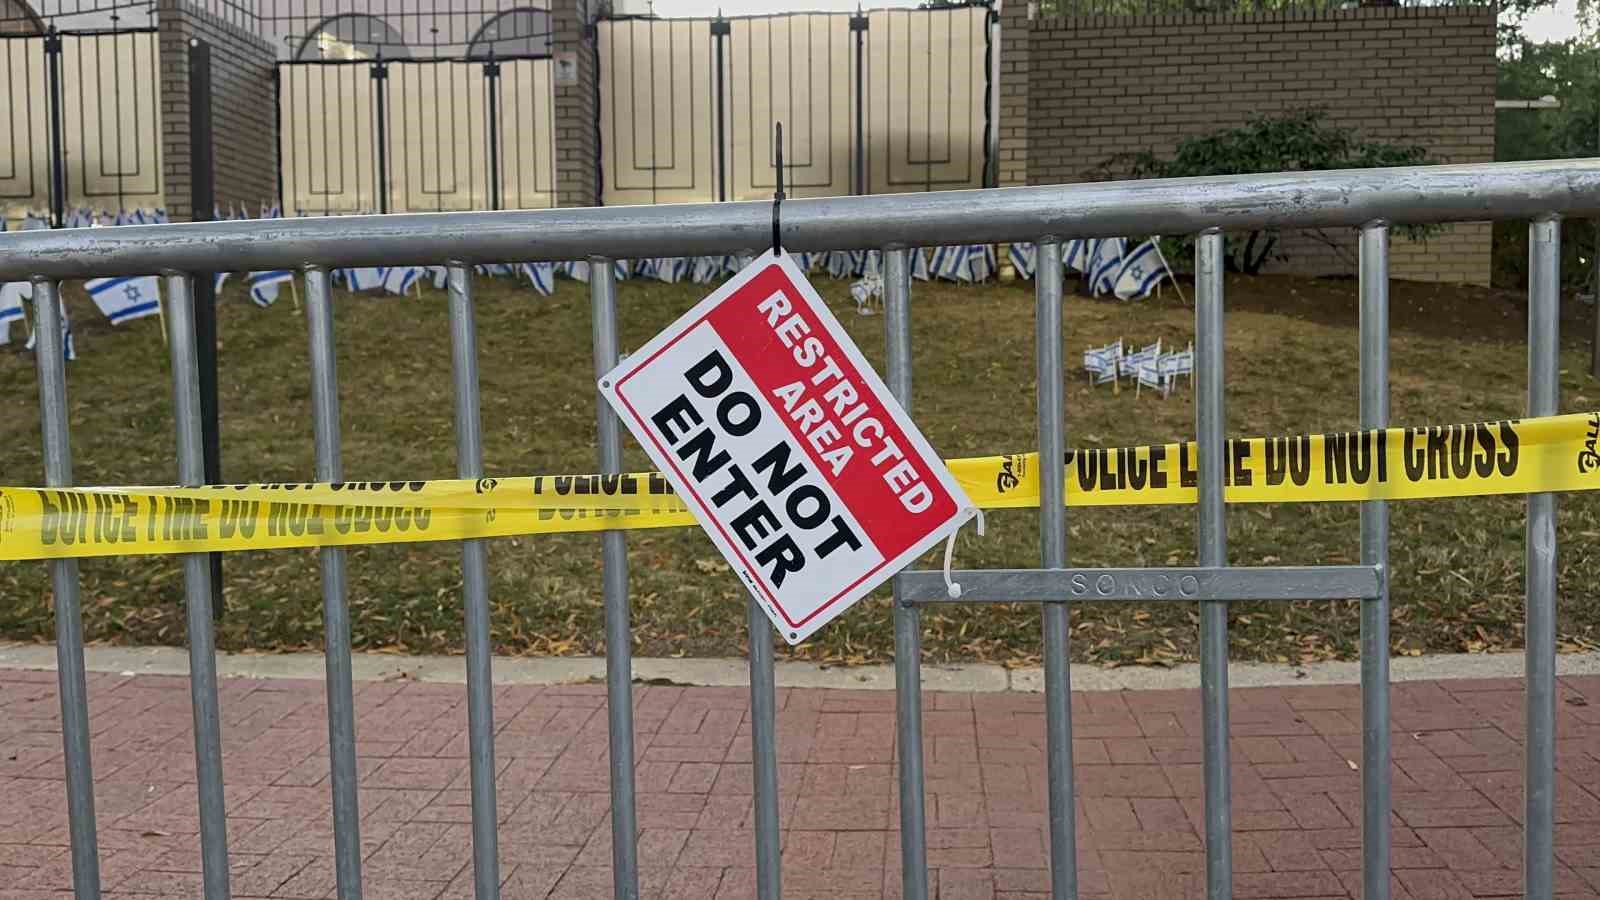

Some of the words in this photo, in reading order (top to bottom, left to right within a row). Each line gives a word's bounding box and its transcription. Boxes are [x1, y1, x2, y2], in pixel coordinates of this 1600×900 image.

[684, 349, 762, 436] DO
[752, 441, 862, 559] NOT
[756, 289, 933, 514] RESTRICTED
[772, 380, 855, 477] AREA
[1064, 446, 1168, 491] OLICE
[1180, 439, 1252, 488] LE
[1265, 435, 1310, 486] DO
[1404, 420, 1520, 482] CROSS
[651, 394, 806, 589] ENTER
[1071, 574, 1200, 597] SONCO
